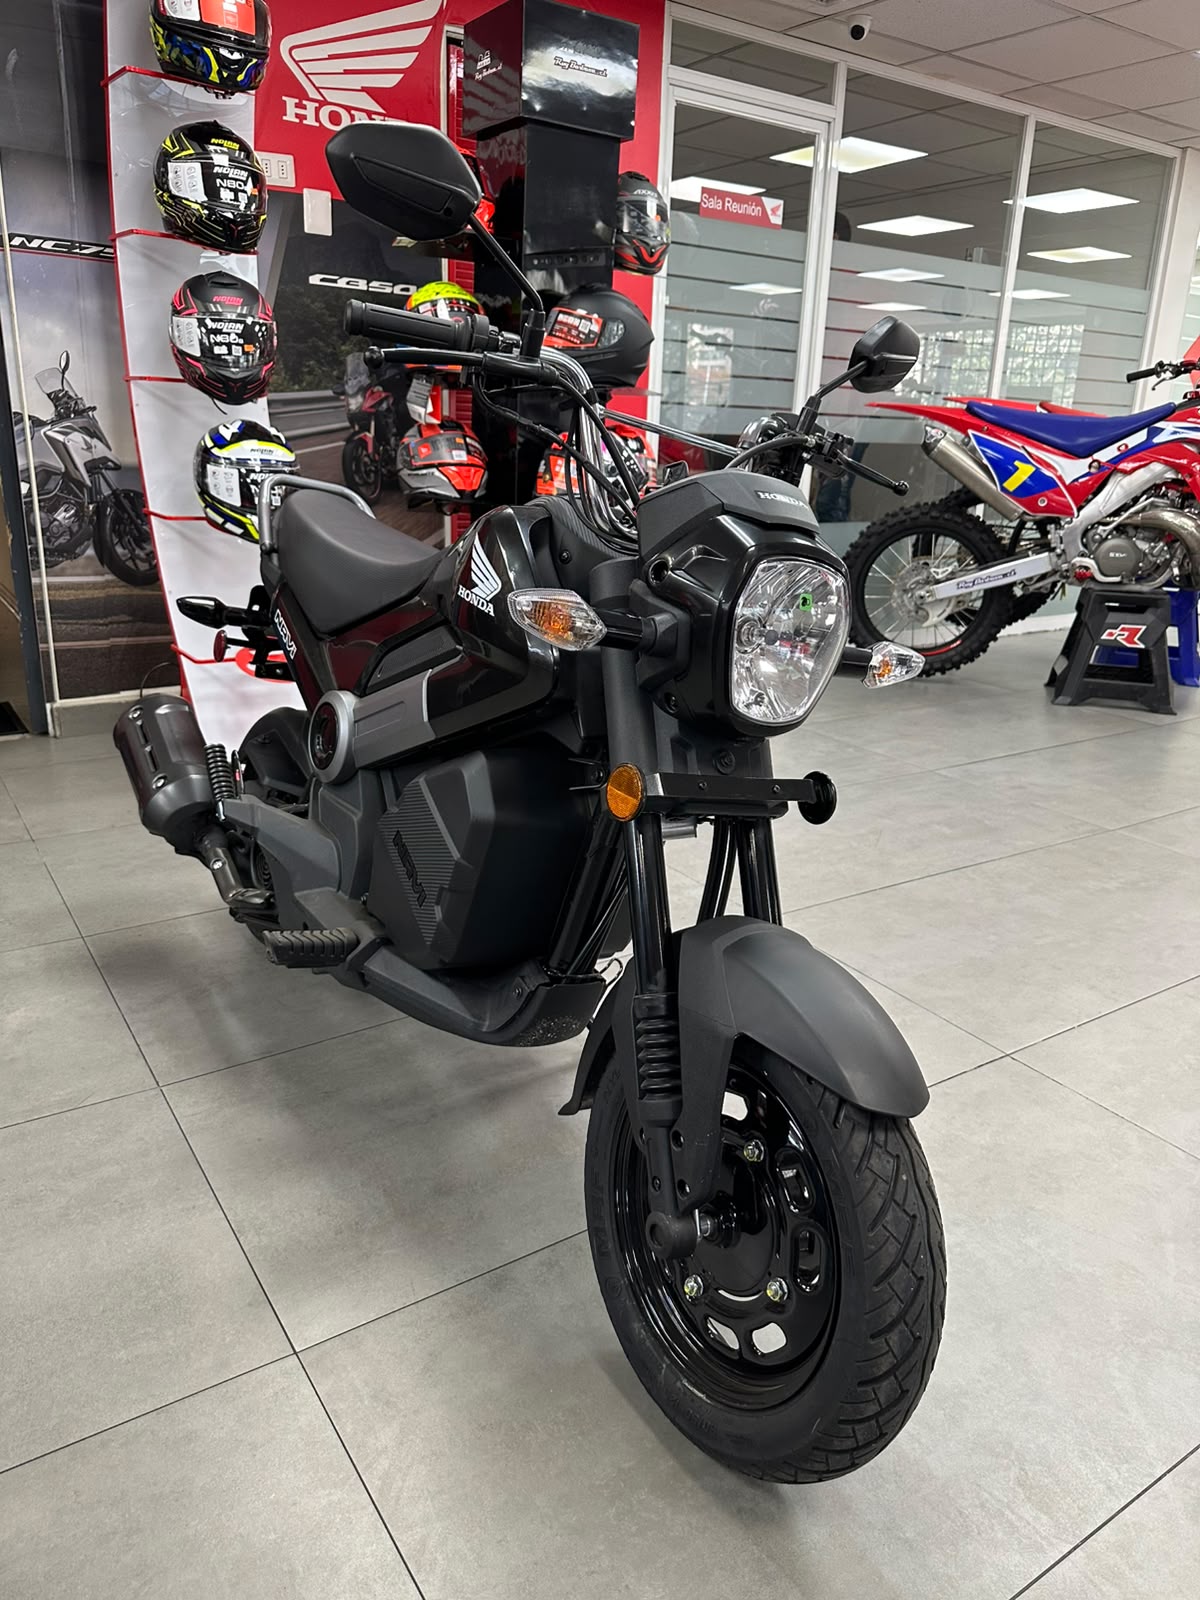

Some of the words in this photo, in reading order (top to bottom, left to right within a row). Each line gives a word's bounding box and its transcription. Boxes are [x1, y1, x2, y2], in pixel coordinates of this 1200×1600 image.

[210, 138, 240, 150] NOLAN
[212, 166, 249, 181] NOLAN
[701, 193, 723, 211] Sala
[724, 197, 763, 217] Reunión
[212, 295, 244, 306] NOLAN
[207, 321, 244, 334] NOLAN
[1002, 460, 1036, 492] 1
[756, 491, 810, 511] HONDA
[457, 584, 496, 617] HONDA
[273, 608, 298, 660] NAVI
